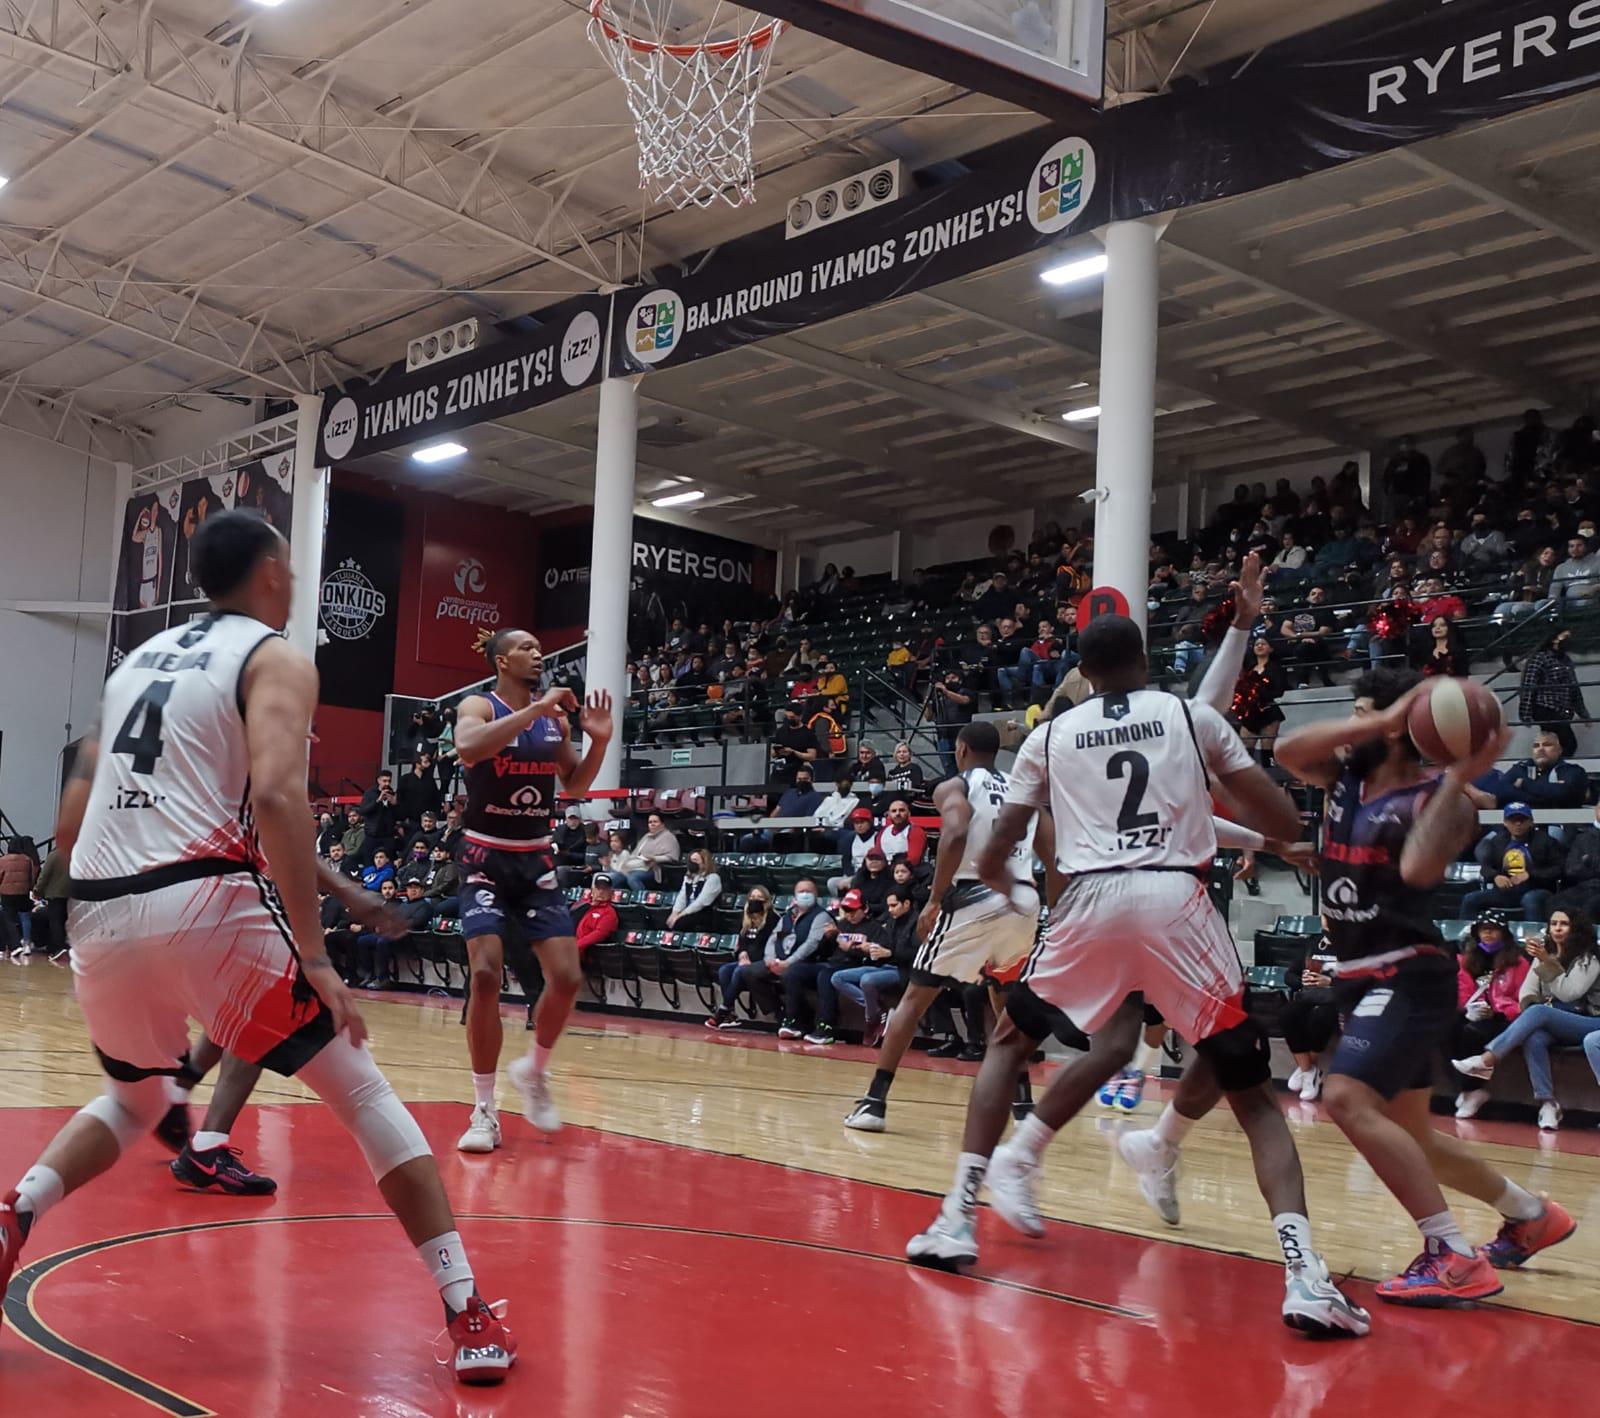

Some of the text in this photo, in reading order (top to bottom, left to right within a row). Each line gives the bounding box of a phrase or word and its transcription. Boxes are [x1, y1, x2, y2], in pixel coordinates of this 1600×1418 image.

[686, 271, 803, 332] BAJAROUND
[632, 541, 752, 584] RYERSON
[323, 583, 385, 615] ONKIDS
[110, 680, 177, 775] 4
[1075, 720, 1166, 750] DENTMOND
[1106, 750, 1160, 834] 2
